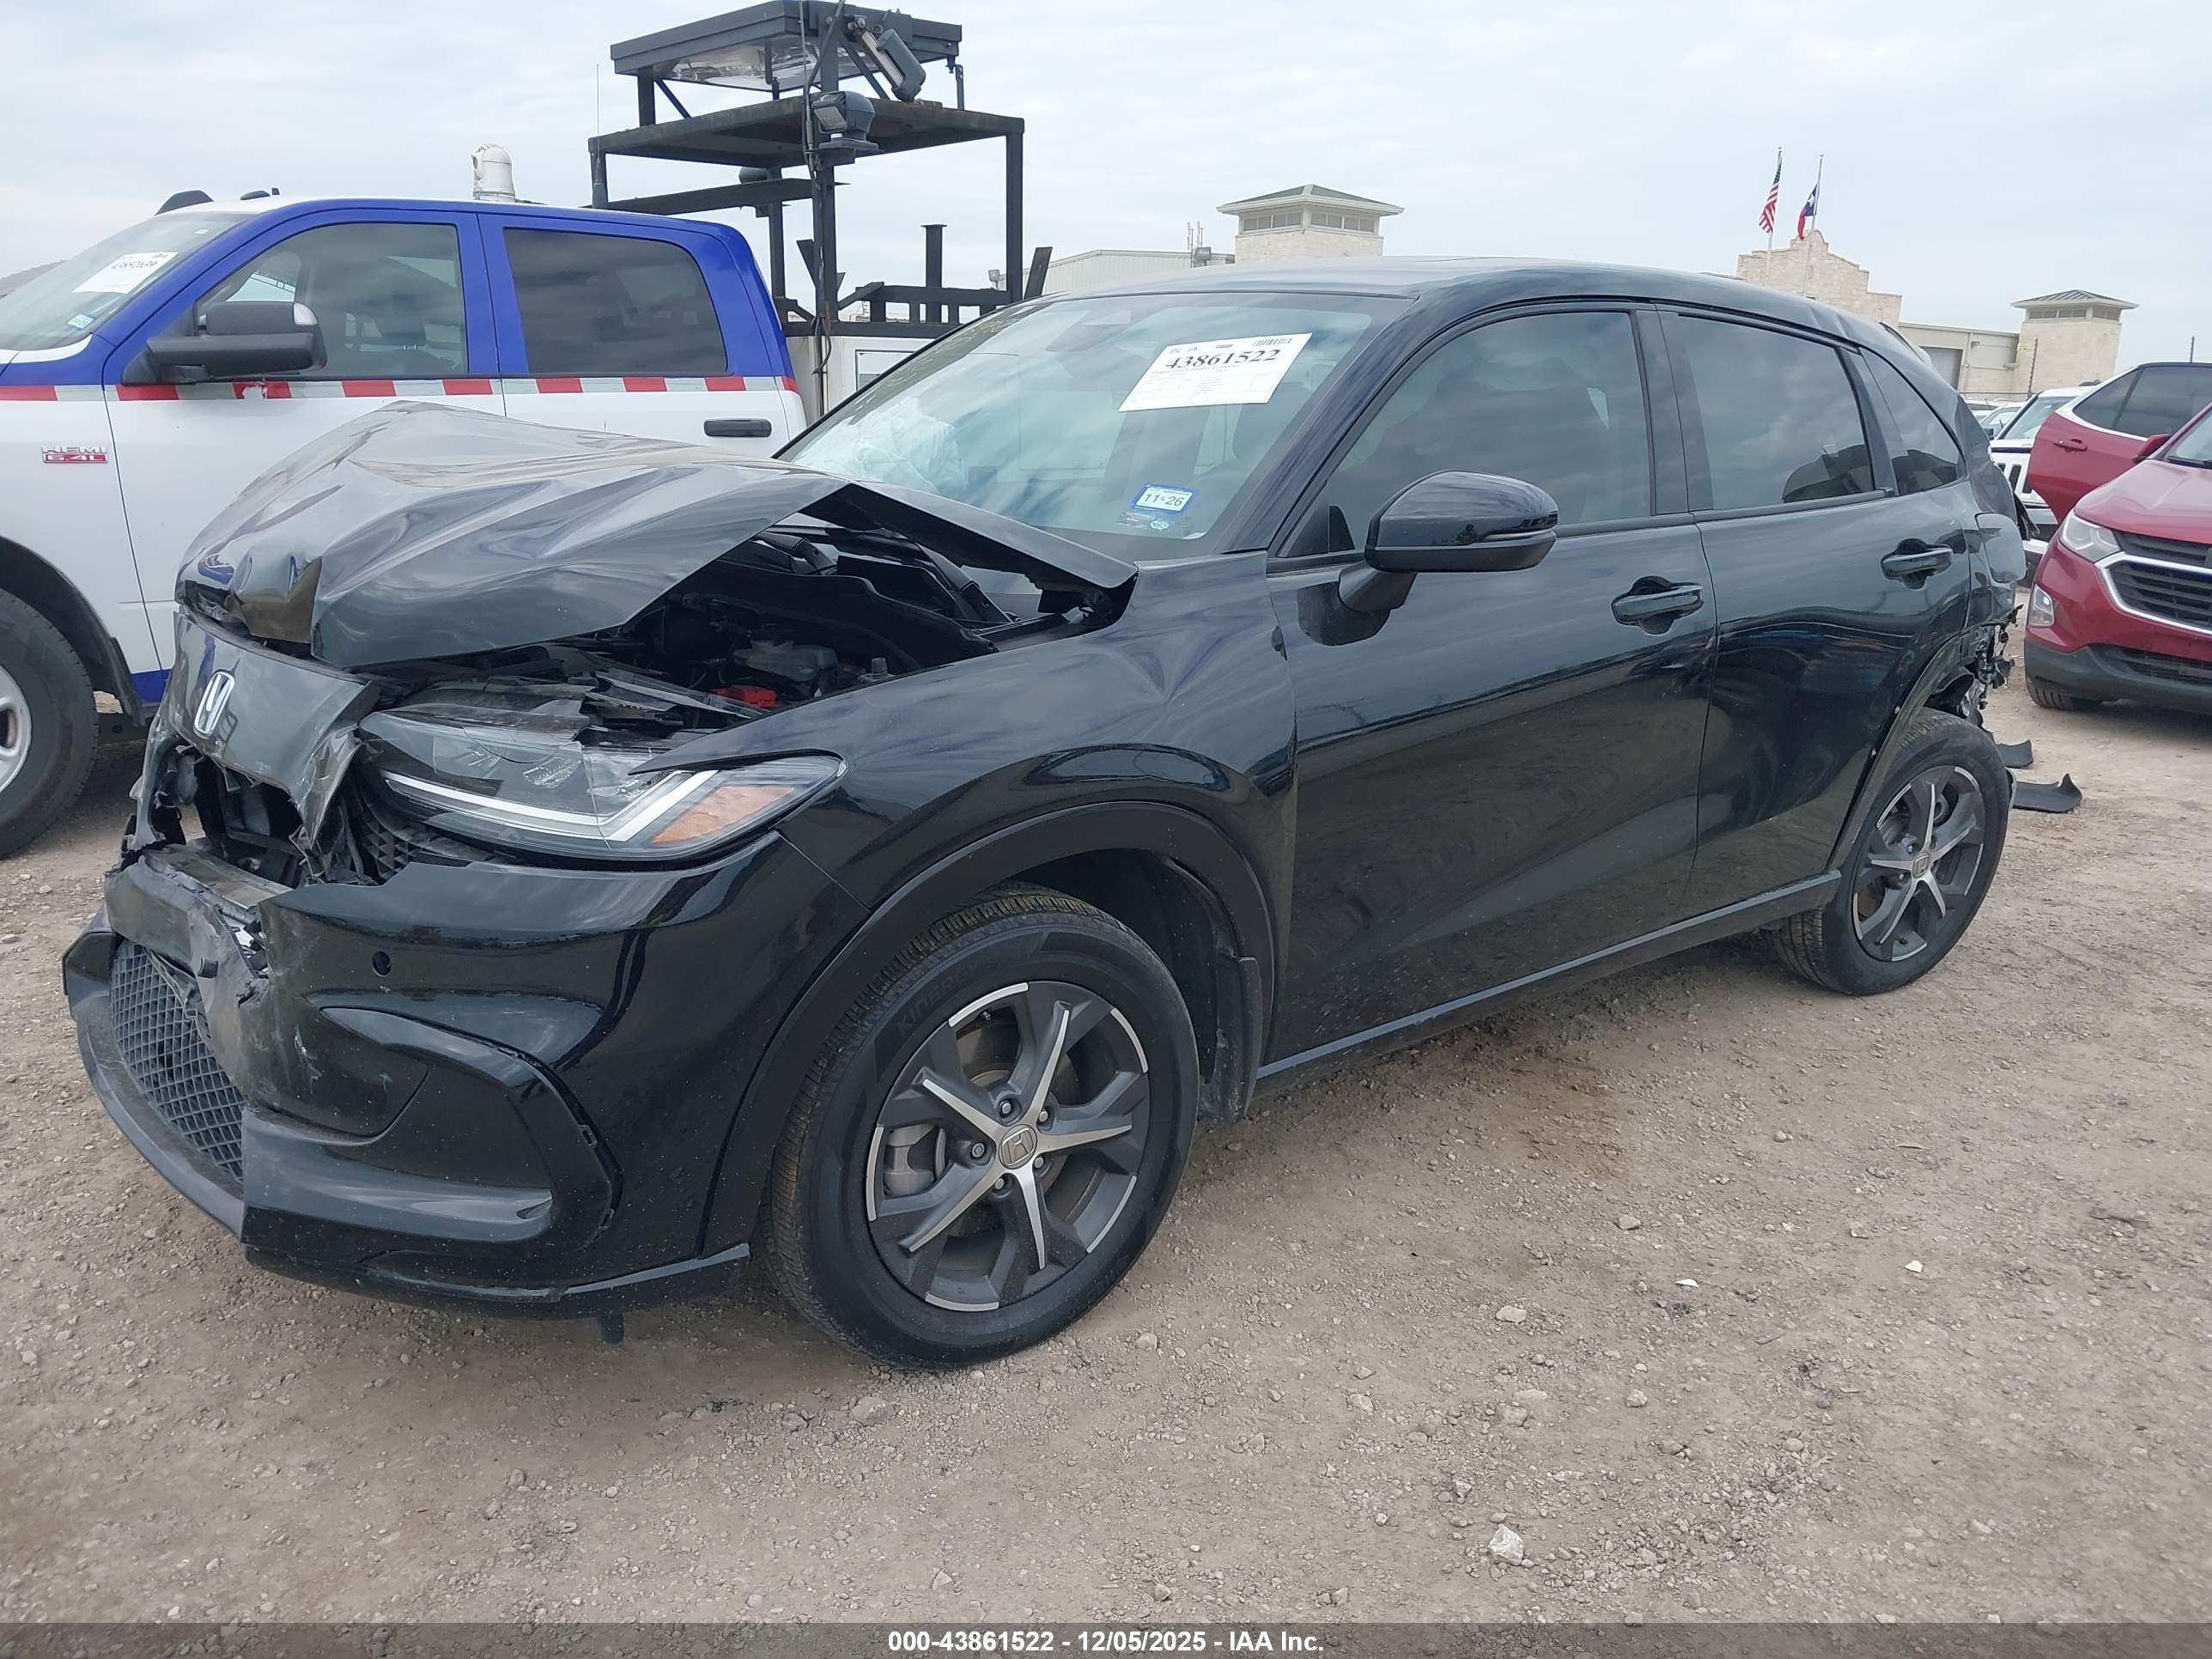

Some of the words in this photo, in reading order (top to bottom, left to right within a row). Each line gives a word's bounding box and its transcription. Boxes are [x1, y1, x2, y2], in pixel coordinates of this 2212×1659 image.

[1165, 349, 1281, 369] 43861522
[1145, 493, 1161, 503] 11
[1165, 495, 1185, 507] 26
